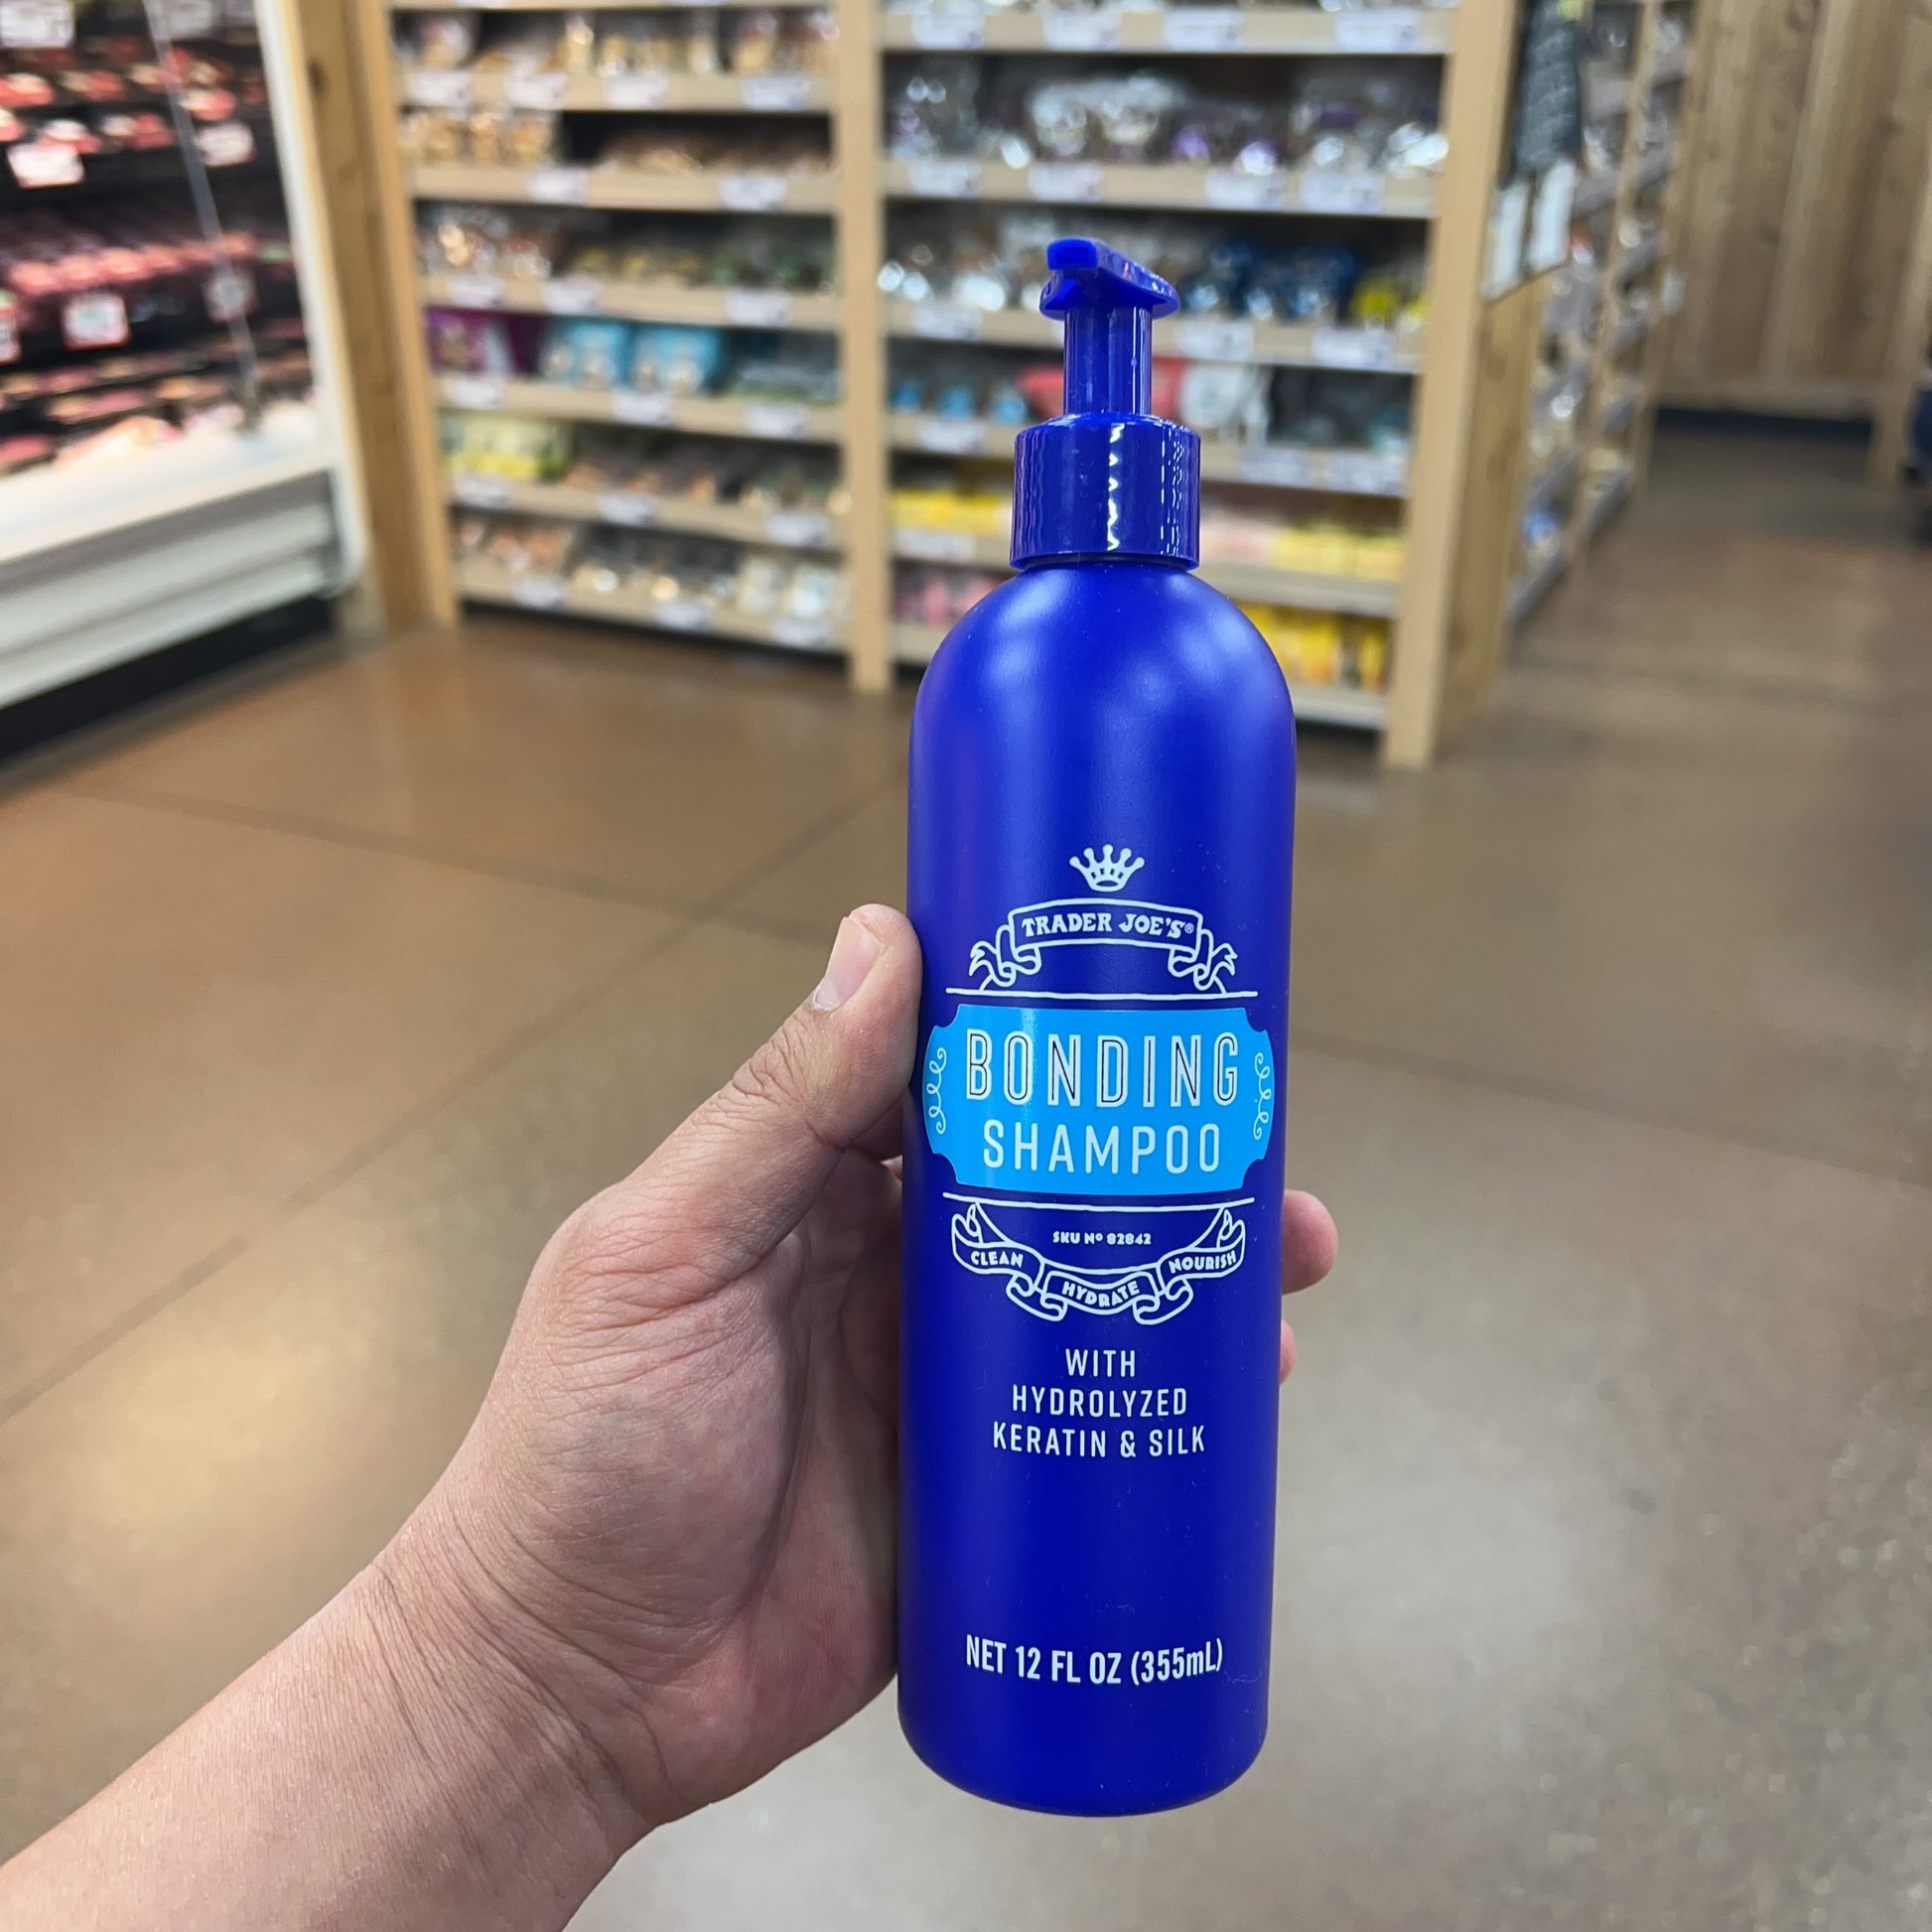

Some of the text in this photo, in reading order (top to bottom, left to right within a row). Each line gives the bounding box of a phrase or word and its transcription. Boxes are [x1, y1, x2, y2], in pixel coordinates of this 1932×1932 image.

[1022, 912, 1113, 937] TRADER
[966, 1029, 1238, 1108] BONDING
[983, 1119, 1220, 1174] SHAMPOO
[1052, 1230, 1081, 1244] SKU
[1106, 1232, 1152, 1245] 82842
[970, 1249, 1238, 1309] CLEAN HYDRATE NOURISH
[1065, 1348, 1136, 1378] WITH
[1012, 1384, 1187, 1418] HYDROLYZED
[993, 1421, 1205, 1457] KERATIN & SILK
[966, 1634, 1223, 1686] NET 12 FL OZ (355mL)
